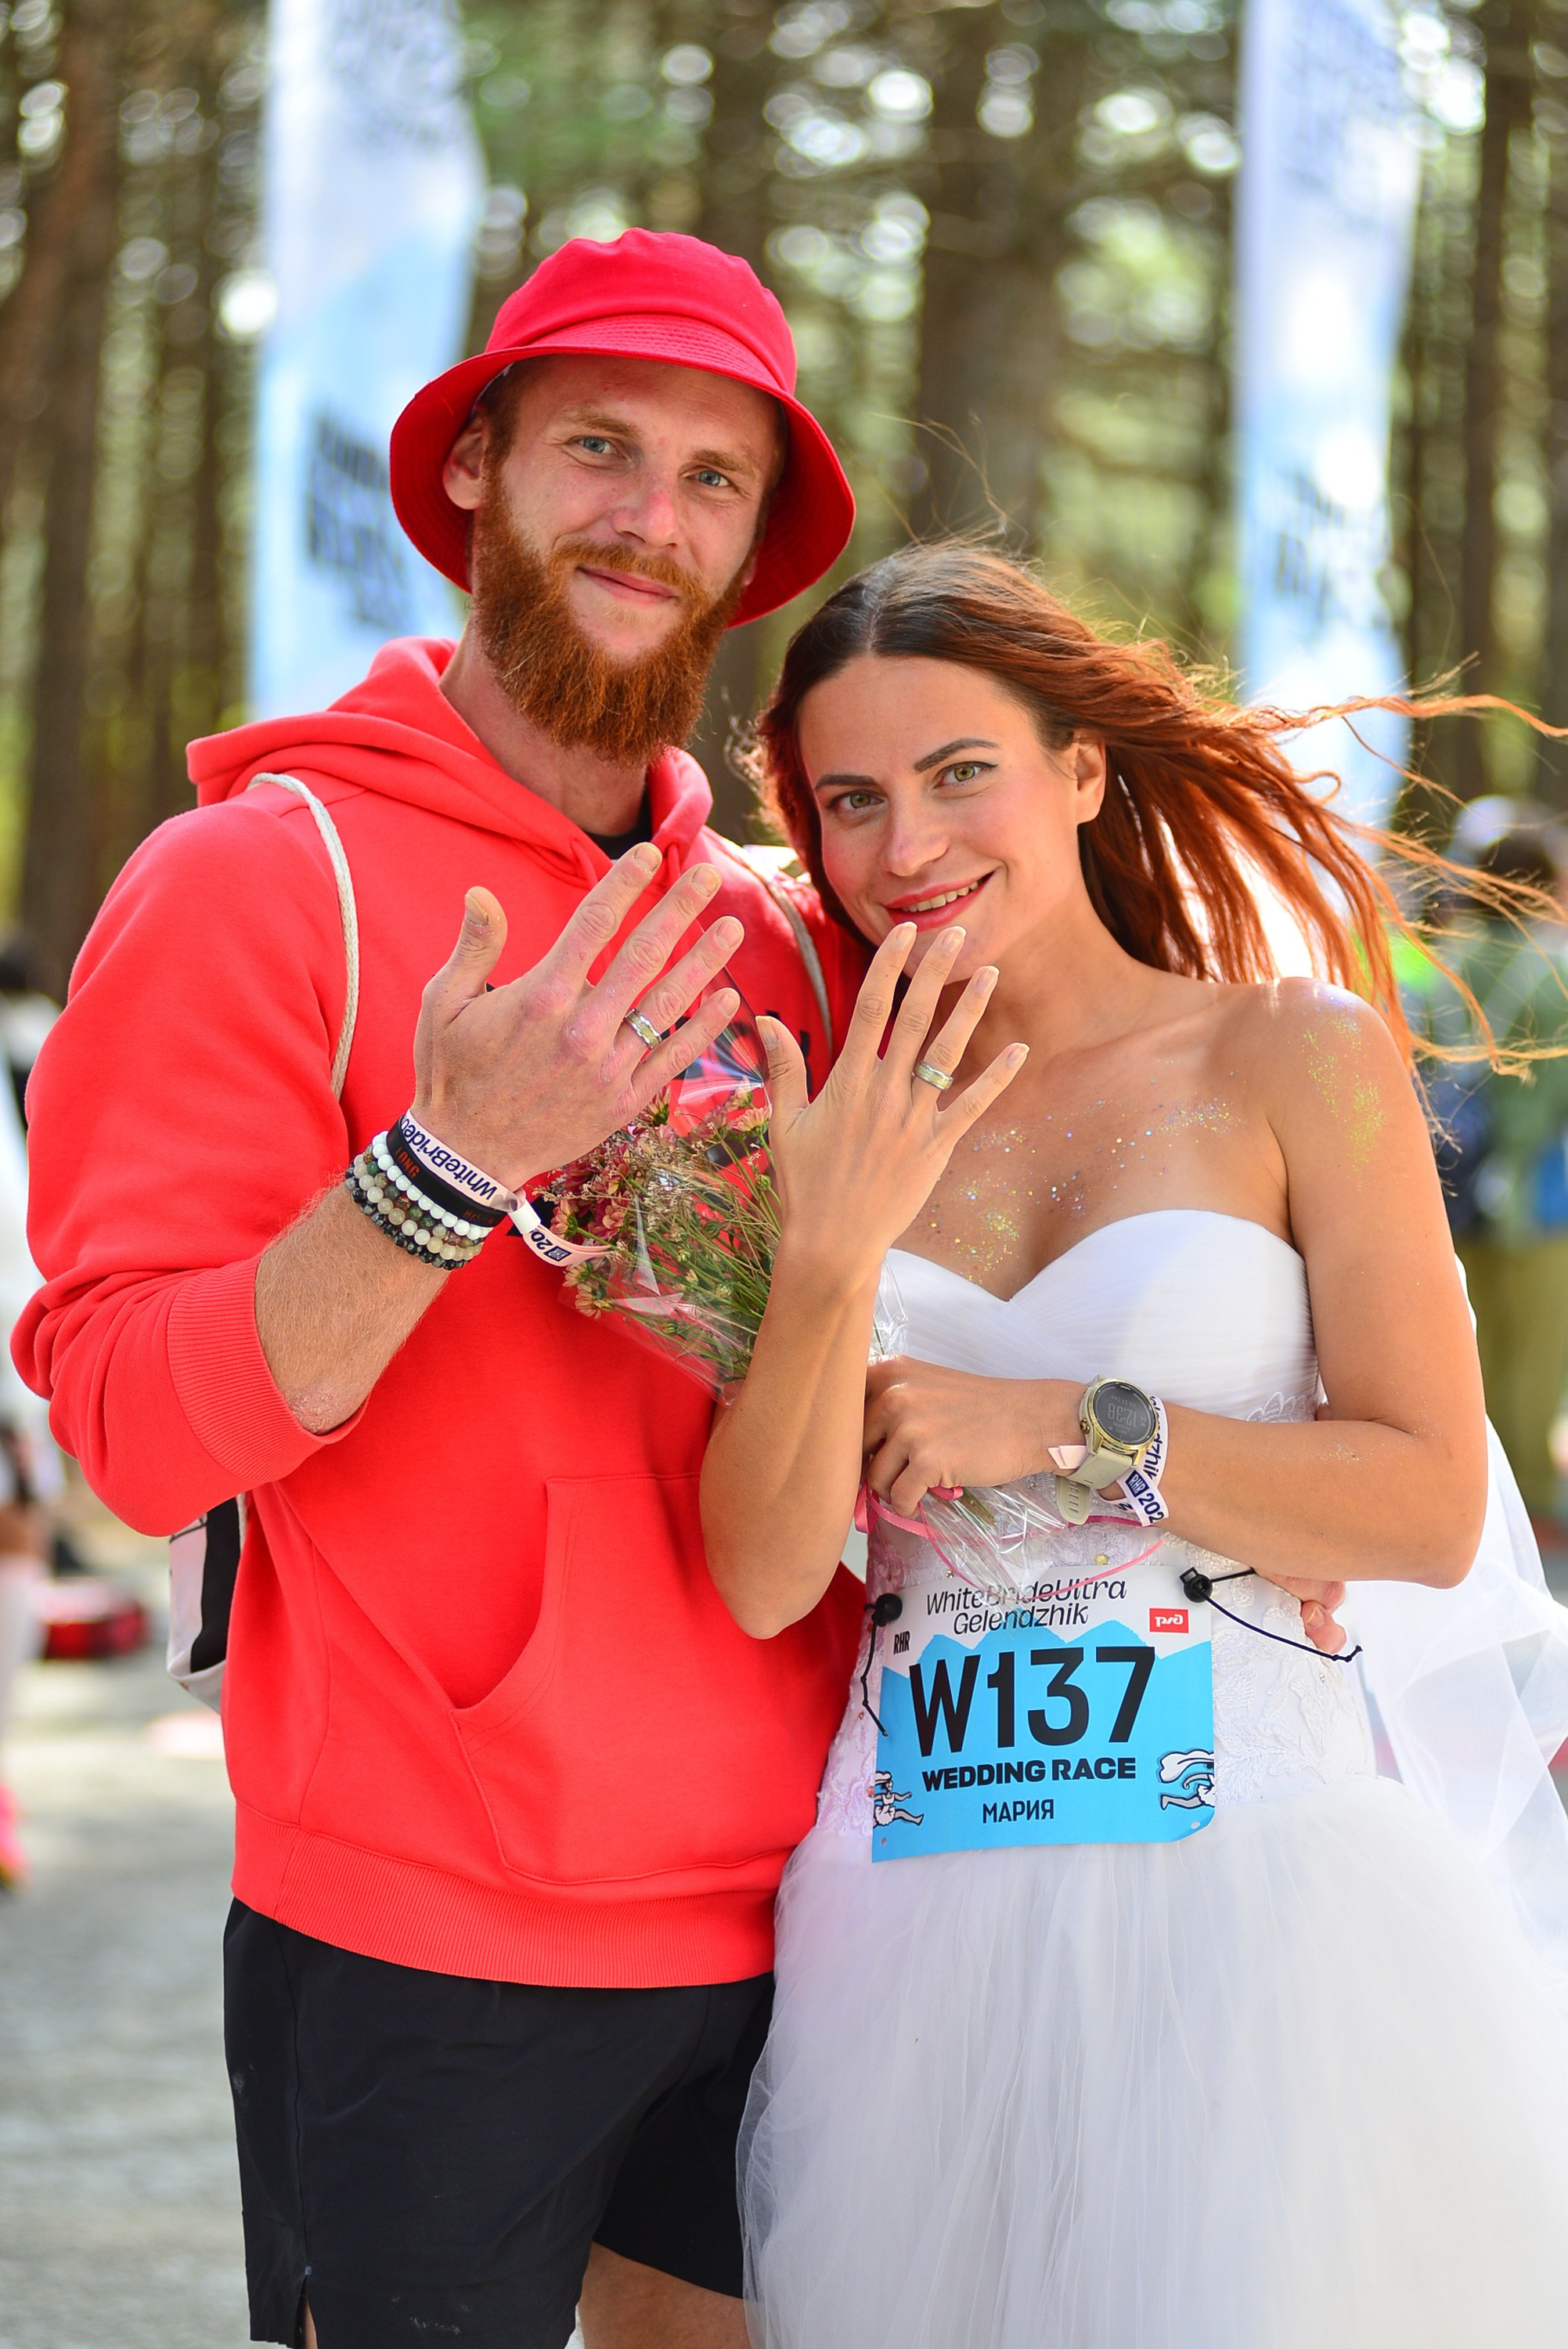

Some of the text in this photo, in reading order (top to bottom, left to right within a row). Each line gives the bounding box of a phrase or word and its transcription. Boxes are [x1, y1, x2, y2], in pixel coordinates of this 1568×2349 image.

[529, 1229, 553, 1250] 20
[1129, 1474, 1146, 1494] RHR
[953, 1602, 1090, 1635] Gelendzhik
[893, 1630, 910, 1655] RHR
[909, 1646, 1155, 1758] W137
[921, 1757, 1137, 1792] WEDDING RACE
[982, 1799, 1055, 1824] МАРИЯ
